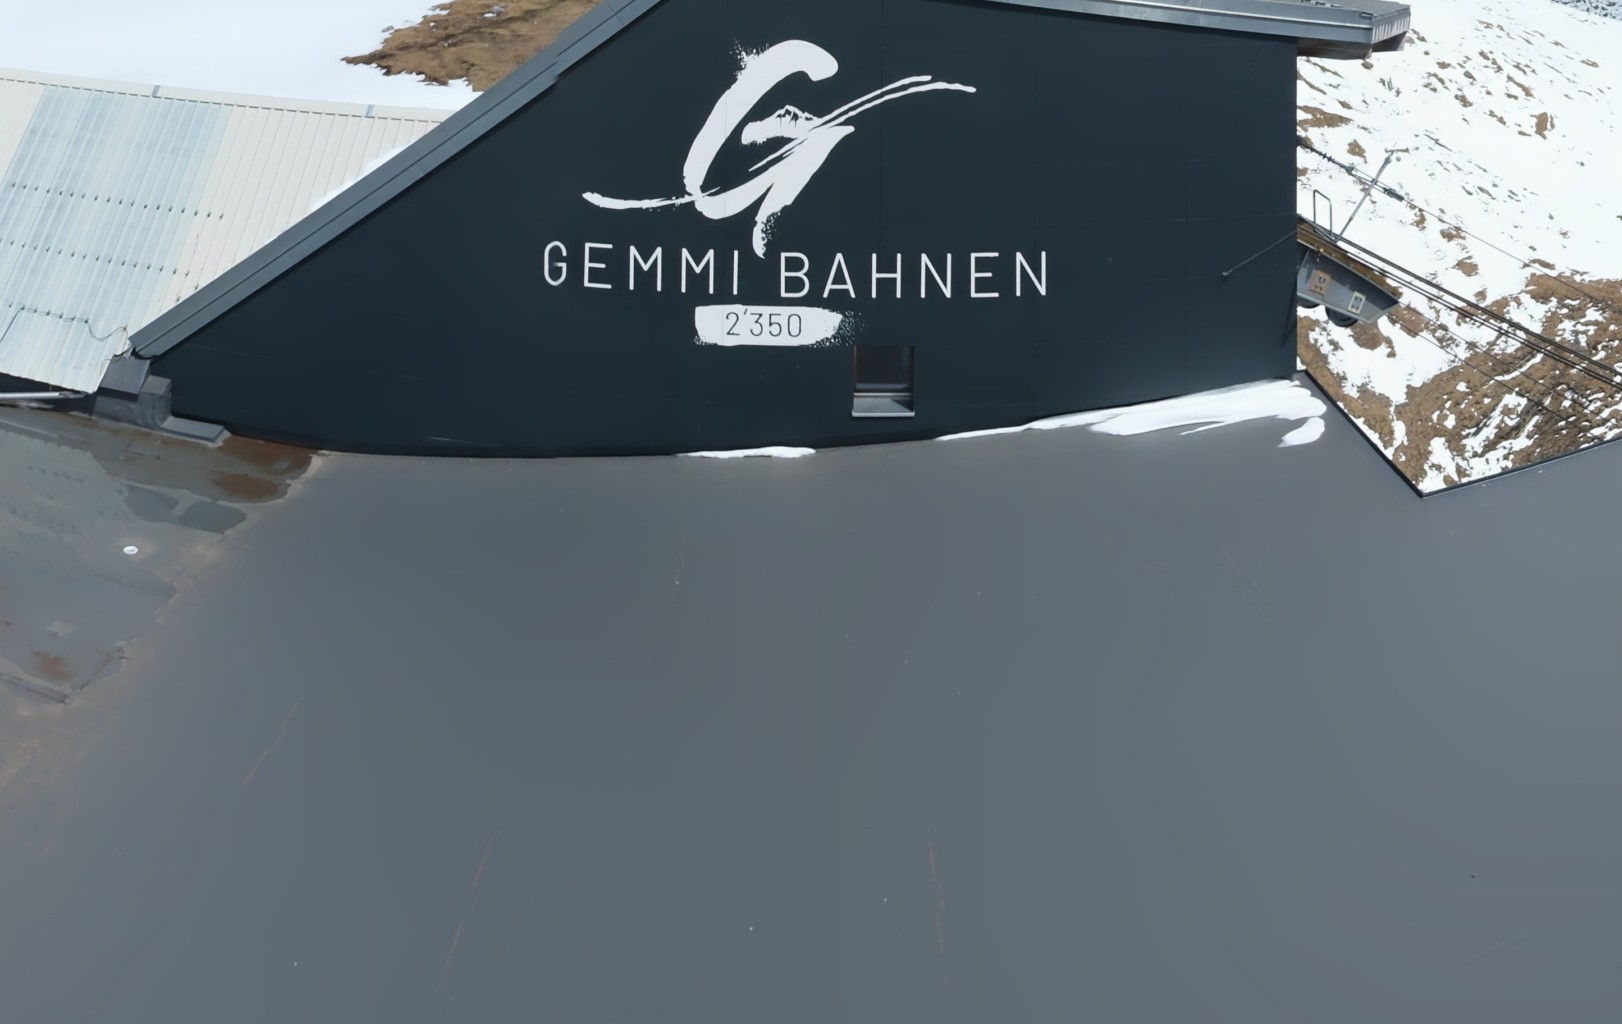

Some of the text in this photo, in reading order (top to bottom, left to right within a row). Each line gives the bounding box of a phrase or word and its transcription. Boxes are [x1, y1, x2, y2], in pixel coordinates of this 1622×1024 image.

[543, 240, 1047, 299] GEMMI BAHNEN
[725, 308, 802, 337] 2'350
